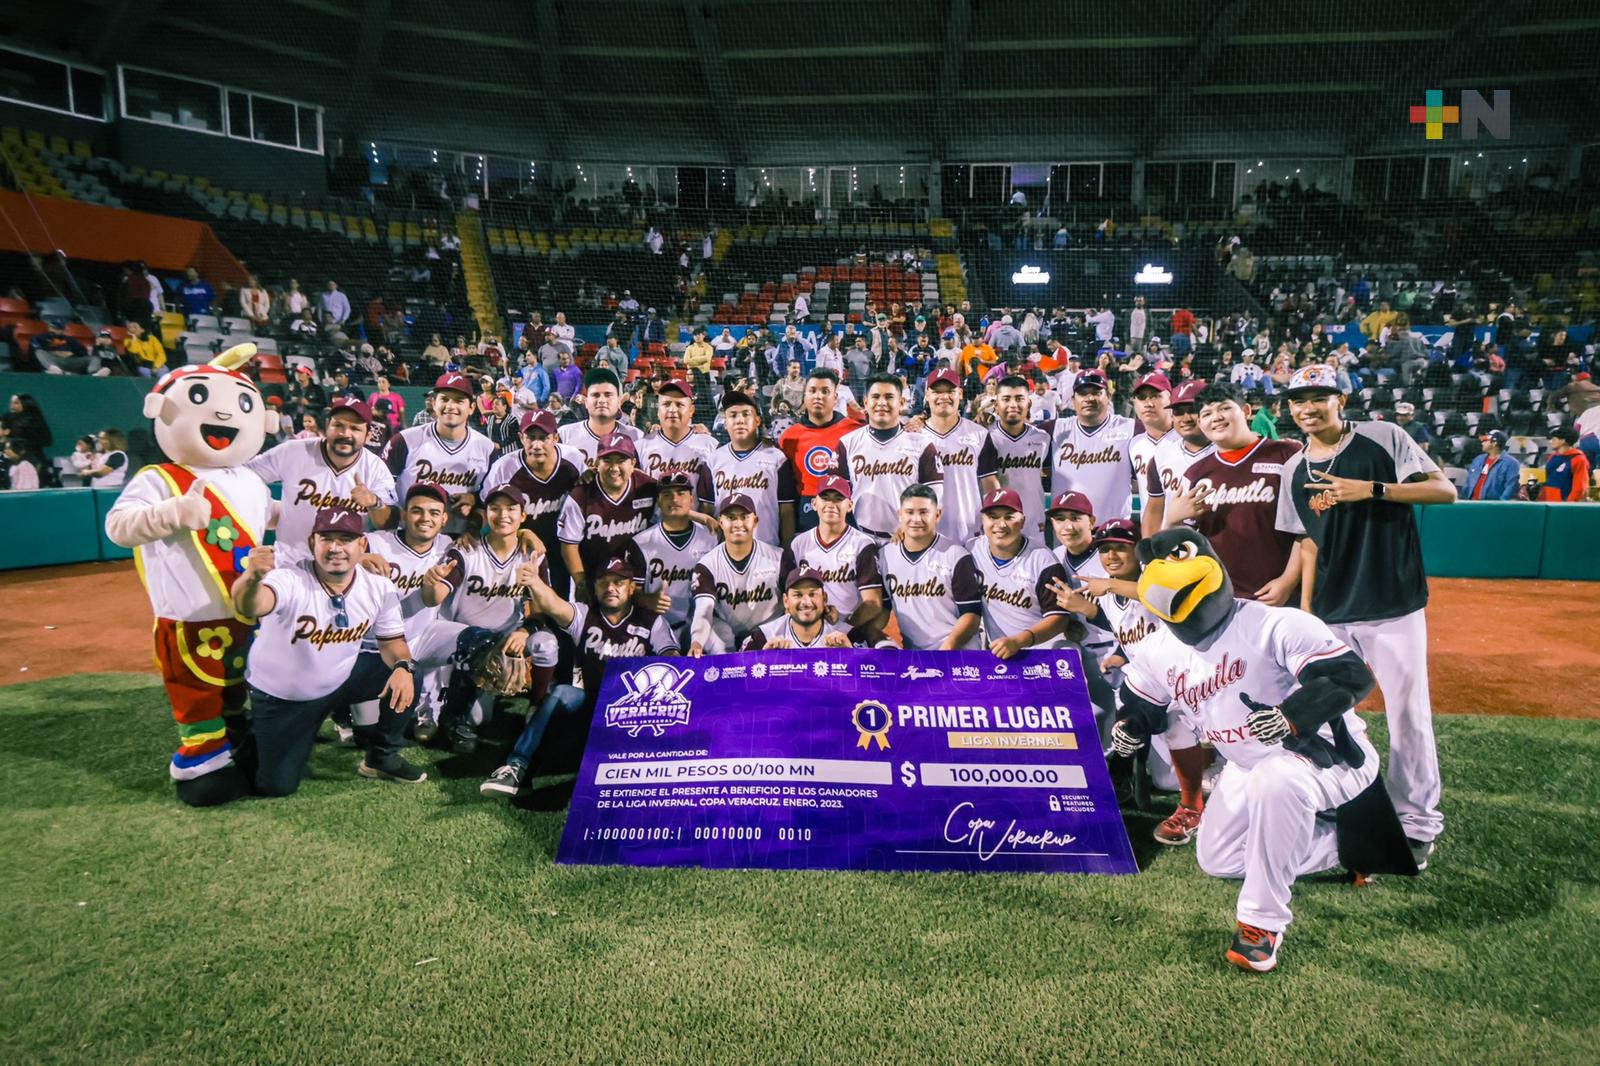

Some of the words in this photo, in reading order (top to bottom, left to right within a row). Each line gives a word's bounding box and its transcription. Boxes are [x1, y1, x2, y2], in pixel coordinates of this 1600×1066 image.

[648, 453, 702, 478] Papantl
[852, 454, 914, 482] Papantla
[996, 450, 1041, 473] apantla
[1059, 443, 1122, 469] Papantla
[715, 470, 769, 497] Papantla
[586, 512, 648, 543] Papantla
[715, 582, 774, 610] Papantla
[885, 573, 946, 603] Papantla
[291, 615, 372, 652] Papantl
[584, 625, 647, 661] Papantla
[609, 704, 688, 722] VERACRUZ
[866, 708, 877, 727] 1
[897, 705, 988, 729] PRIMER
[995, 705, 1074, 729] LUGAR
[960, 736, 993, 746] LIGA
[996, 736, 1064, 747] INVERNAL
[608, 752, 628, 760] VALE
[628, 751, 645, 759] POR
[656, 749, 695, 758] CANTIDAD
[605, 768, 642, 779] CIEN
[646, 766, 673, 778] MIL
[677, 764, 728, 777] PESOS
[732, 762, 785, 777] 00/100
[789, 764, 815, 776] MN
[900, 760, 917, 788] $
[949, 768, 1059, 785] 100,000.00
[597, 800, 611, 808] DE
[611, 800, 625, 808] LA
[625, 799, 648, 808] LIGA
[648, 798, 698, 808] INVERNAL,
[699, 797, 726, 806] COPA
[782, 798, 819, 809] ENERO,
[820, 799, 845, 808] 2023.
[599, 789, 612, 798] SE
[612, 788, 658, 797] EXTIENDE
[658, 787, 671, 796] EL
[671, 786, 720, 796] PRESENTE
[720, 786, 729, 795] A
[730, 786, 781, 795] BENEFICIO
[782, 786, 796, 795] DE
[798, 787, 817, 796] LOS
[818, 787, 879, 798] GANADORES
[694, 826, 761, 840] 00010000
[779, 828, 811, 841] 0010
[943, 801, 996, 846] Copa
